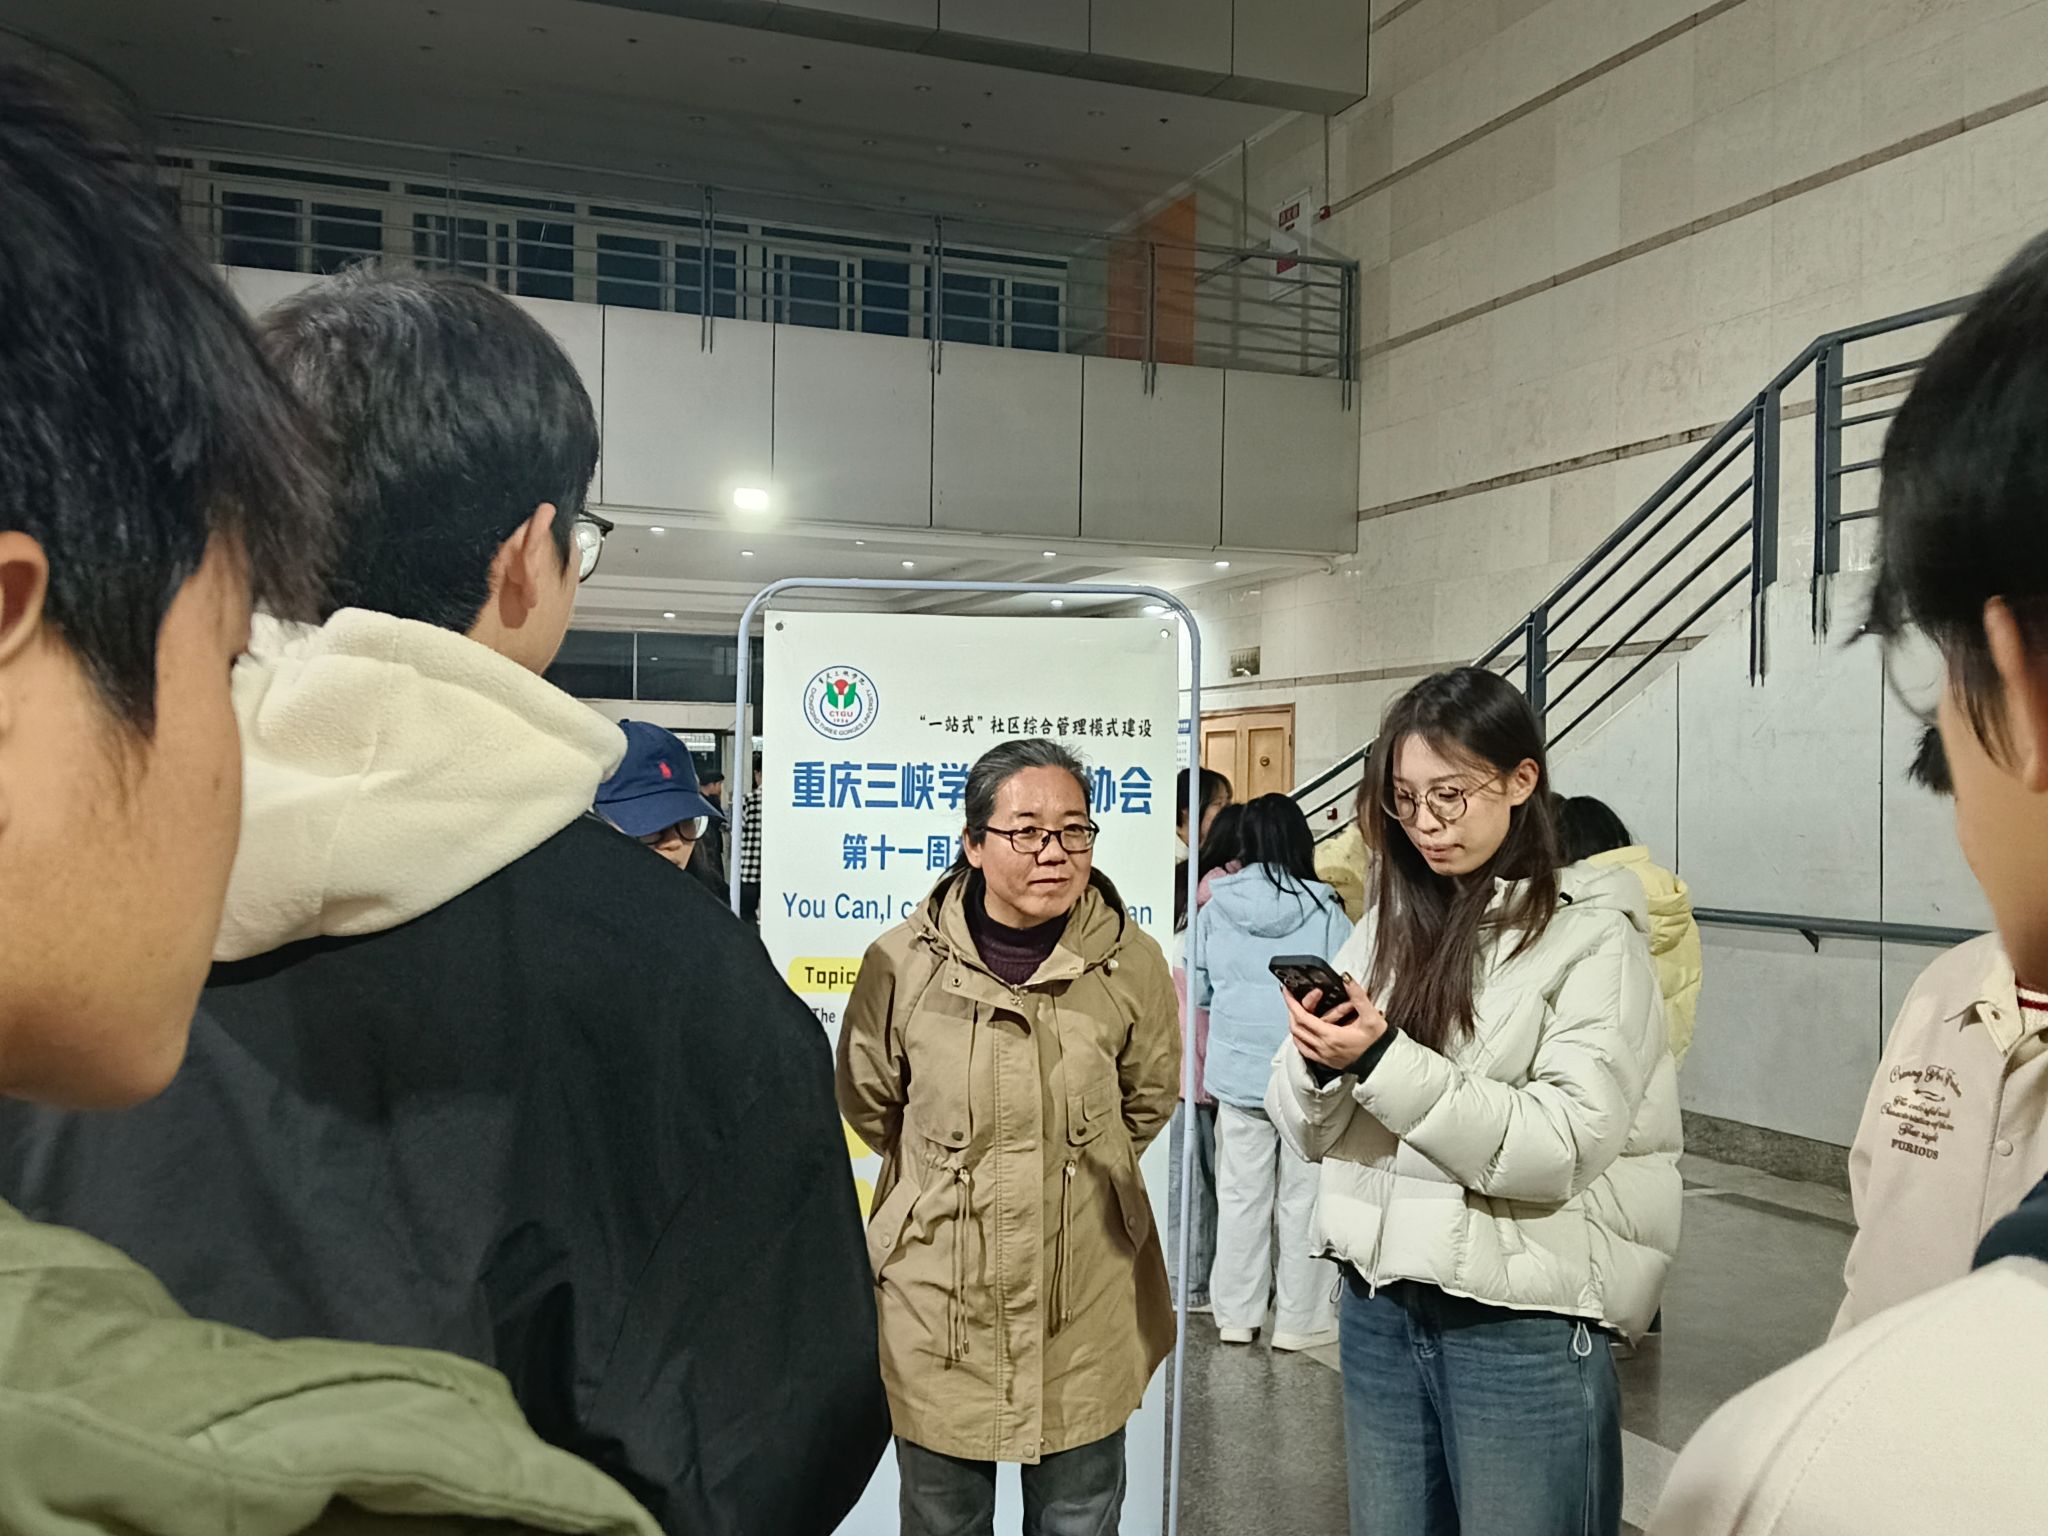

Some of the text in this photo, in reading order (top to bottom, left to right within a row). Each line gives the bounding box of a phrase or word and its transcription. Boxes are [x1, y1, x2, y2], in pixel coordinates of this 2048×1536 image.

[829, 710, 854, 718] CTGU
[843, 833, 964, 871] 第十一周
[783, 892, 826, 919] You
[1127, 905, 1153, 925] an
[804, 966, 856, 990] Topic
[1891, 1138, 1939, 1160] FURIOUS
